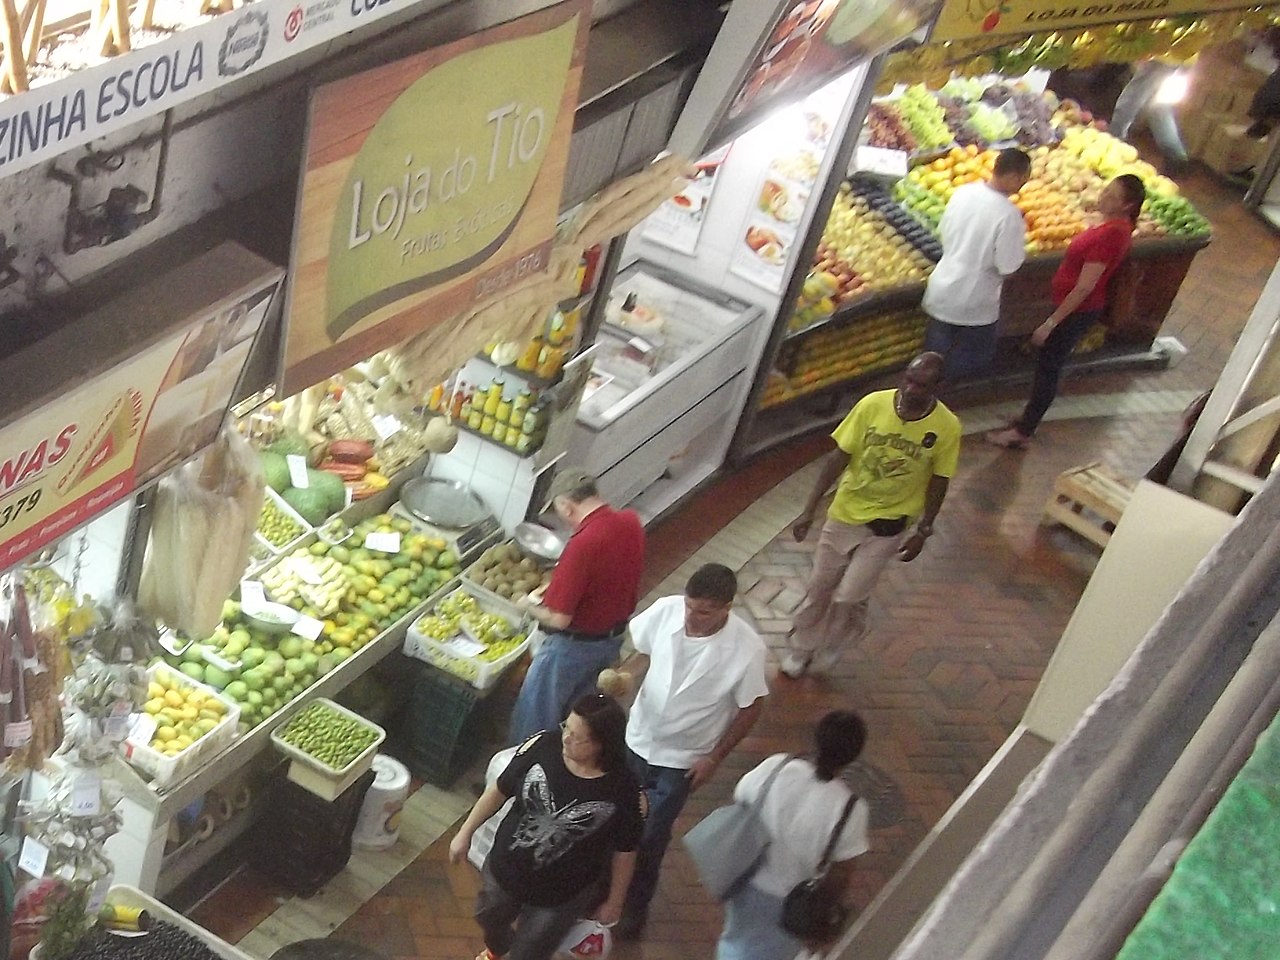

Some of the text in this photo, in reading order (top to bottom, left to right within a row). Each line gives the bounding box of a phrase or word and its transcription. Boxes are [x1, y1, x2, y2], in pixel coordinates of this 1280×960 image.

[96, 40, 204, 124] ESCOLA
[348, 101, 545, 250] Loja do Tio
